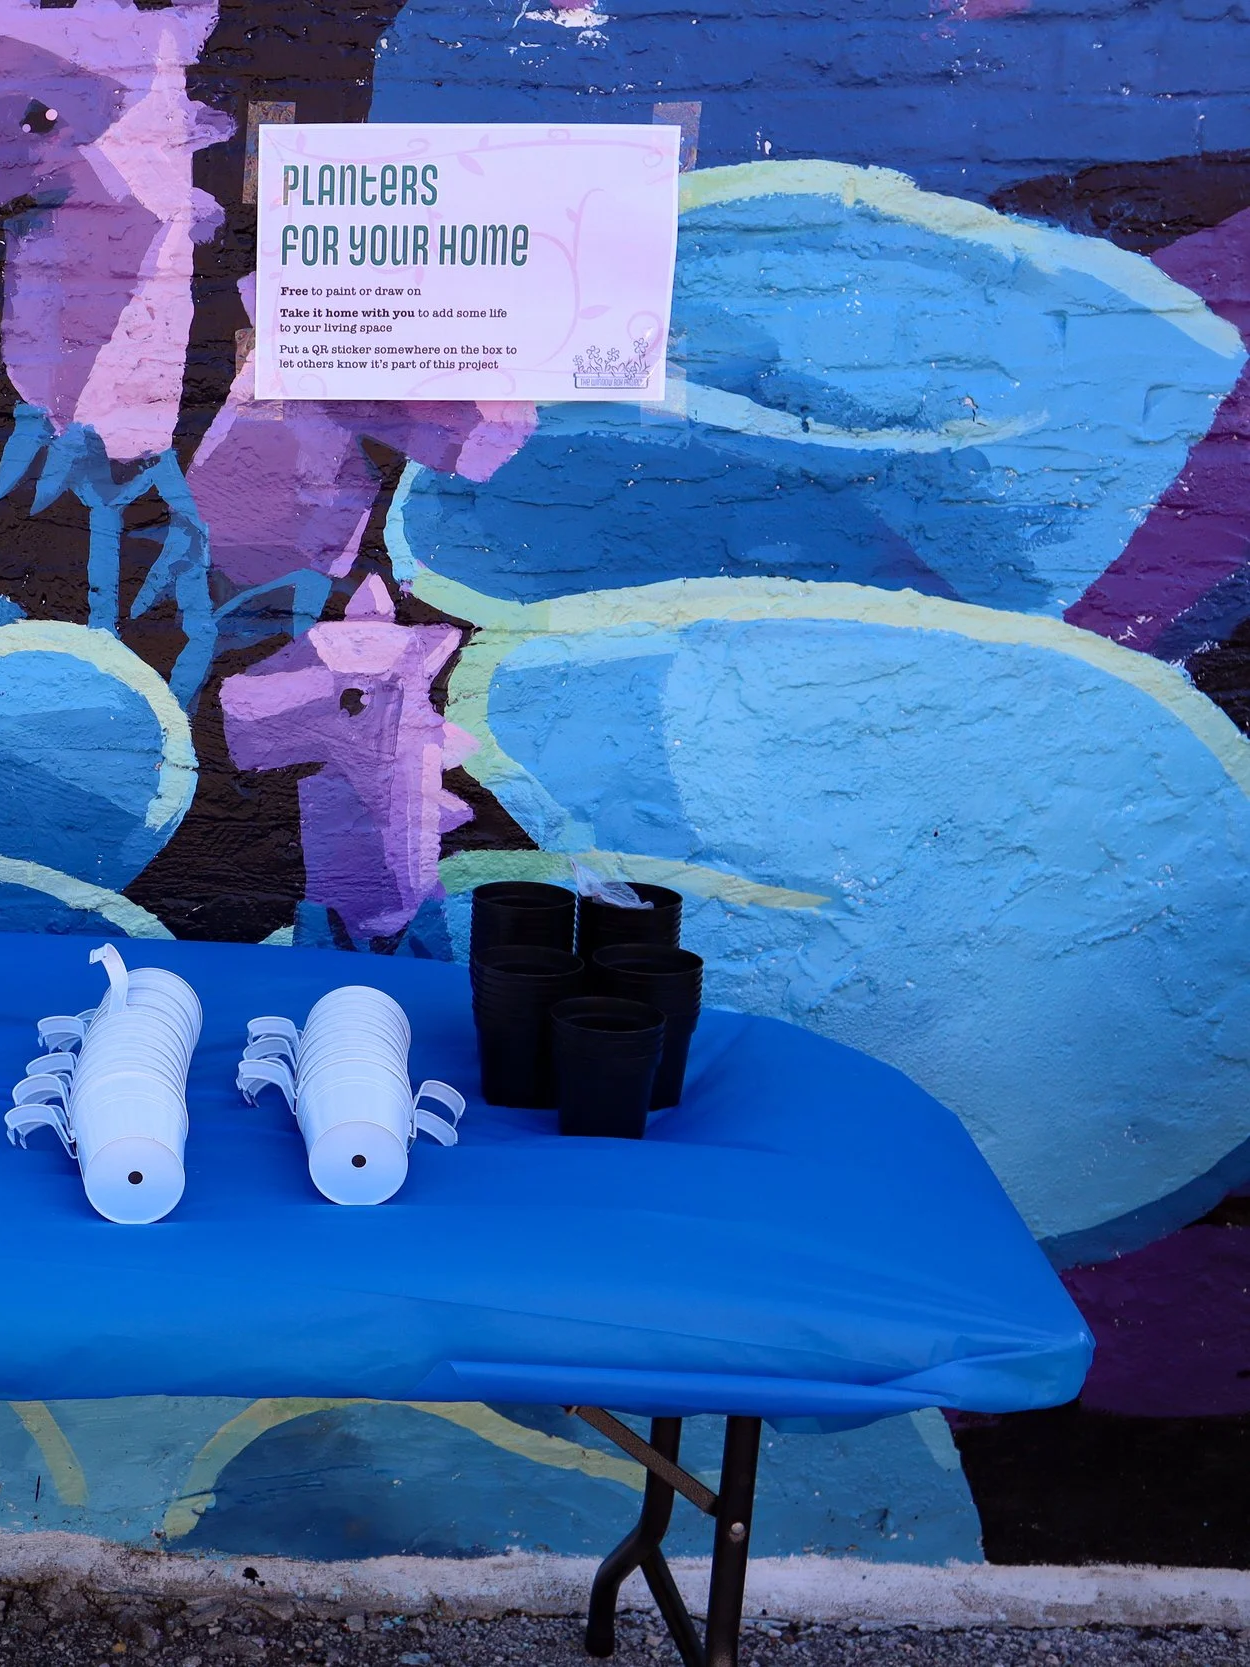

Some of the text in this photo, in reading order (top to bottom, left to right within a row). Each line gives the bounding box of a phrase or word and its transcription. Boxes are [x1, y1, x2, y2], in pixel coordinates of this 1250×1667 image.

[283, 165, 437, 206] PLANTERS
[281, 225, 528, 266] FOR YOUR HOME
[280, 287, 308, 296] Free
[311, 287, 322, 296] to
[325, 287, 356, 297] paint
[375, 287, 404, 295] draw
[280, 309, 310, 317] Take
[313, 308, 322, 317] it
[326, 309, 358, 317] home
[361, 308, 390, 317] with
[392, 311, 415, 320] you
[418, 309, 429, 317] to
[432, 309, 453, 317] add
[489, 309, 507, 317] life
[279, 323, 392, 334] to your living space
[279, 345, 299, 353] Put
[311, 345, 328, 356] QR
[331, 345, 371, 354] sticker
[374, 345, 440, 354] somewhere
[461, 345, 479, 354] the
[483, 346, 502, 354] box
[506, 346, 517, 354] to
[279, 359, 498, 371] let others know it's part of this project
